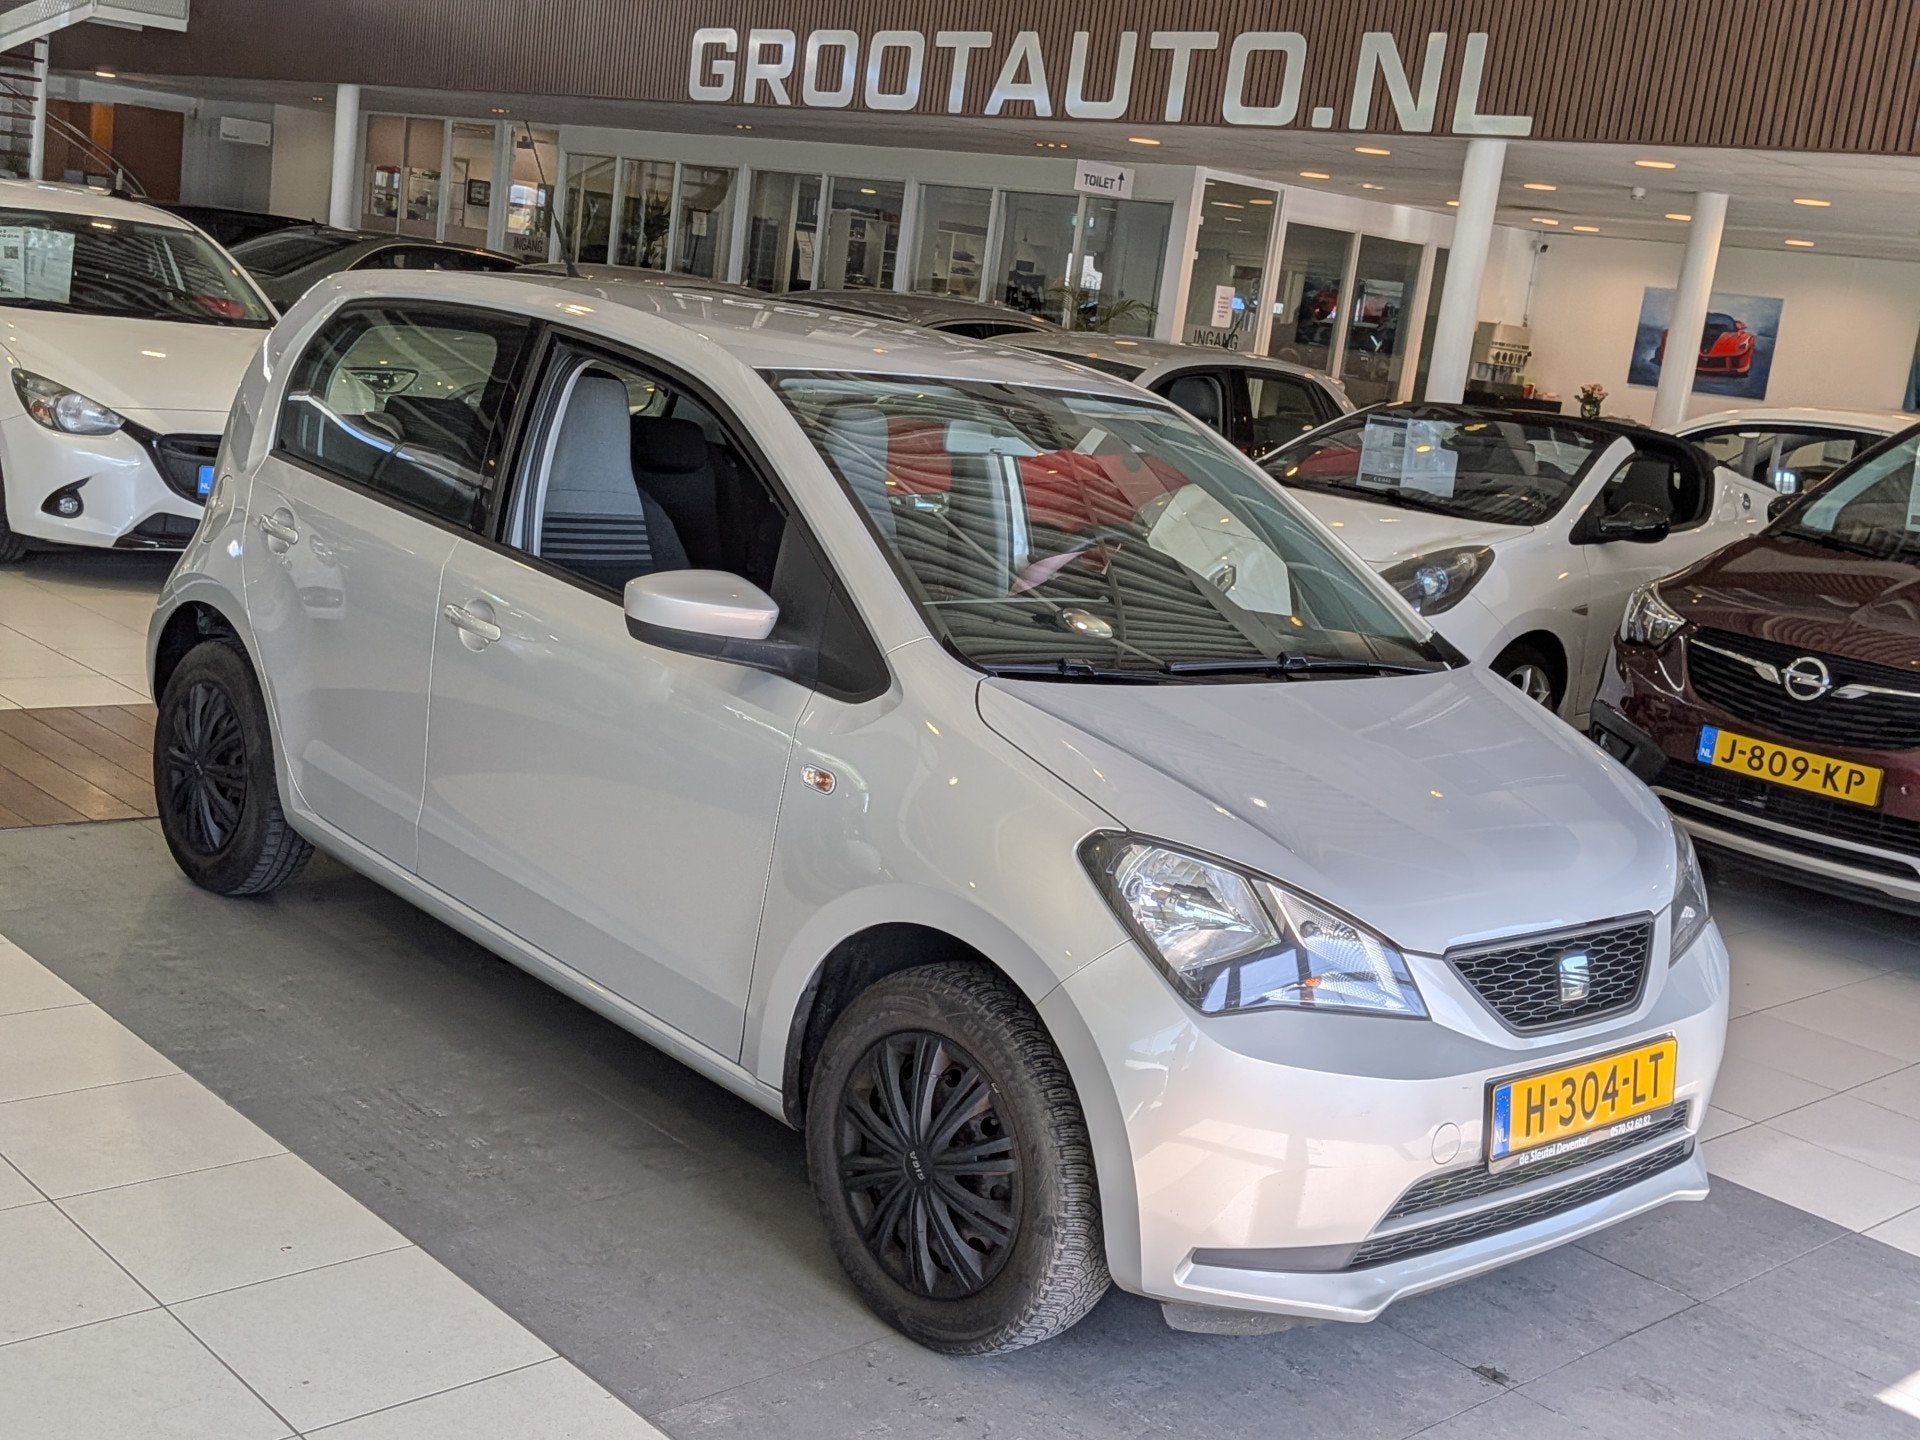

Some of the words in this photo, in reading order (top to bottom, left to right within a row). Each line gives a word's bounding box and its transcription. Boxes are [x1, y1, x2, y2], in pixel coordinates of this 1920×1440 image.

[688, 27, 1533, 137] GROOTAUTO.NL
[1084, 173, 1115, 190] TOILET
[513, 236, 543, 254] INGANG
[1193, 329, 1239, 350] INGANG
[1700, 747, 1712, 758] NL
[1720, 738, 1866, 795] J-809-KP
[1525, 1051, 1664, 1138] H-304-LT
[1495, 1128, 1508, 1143] NL
[1519, 1152, 1530, 1165] de
[1530, 1143, 1556, 1162] Sleutel
[1556, 1136, 1590, 1155] Deventer
